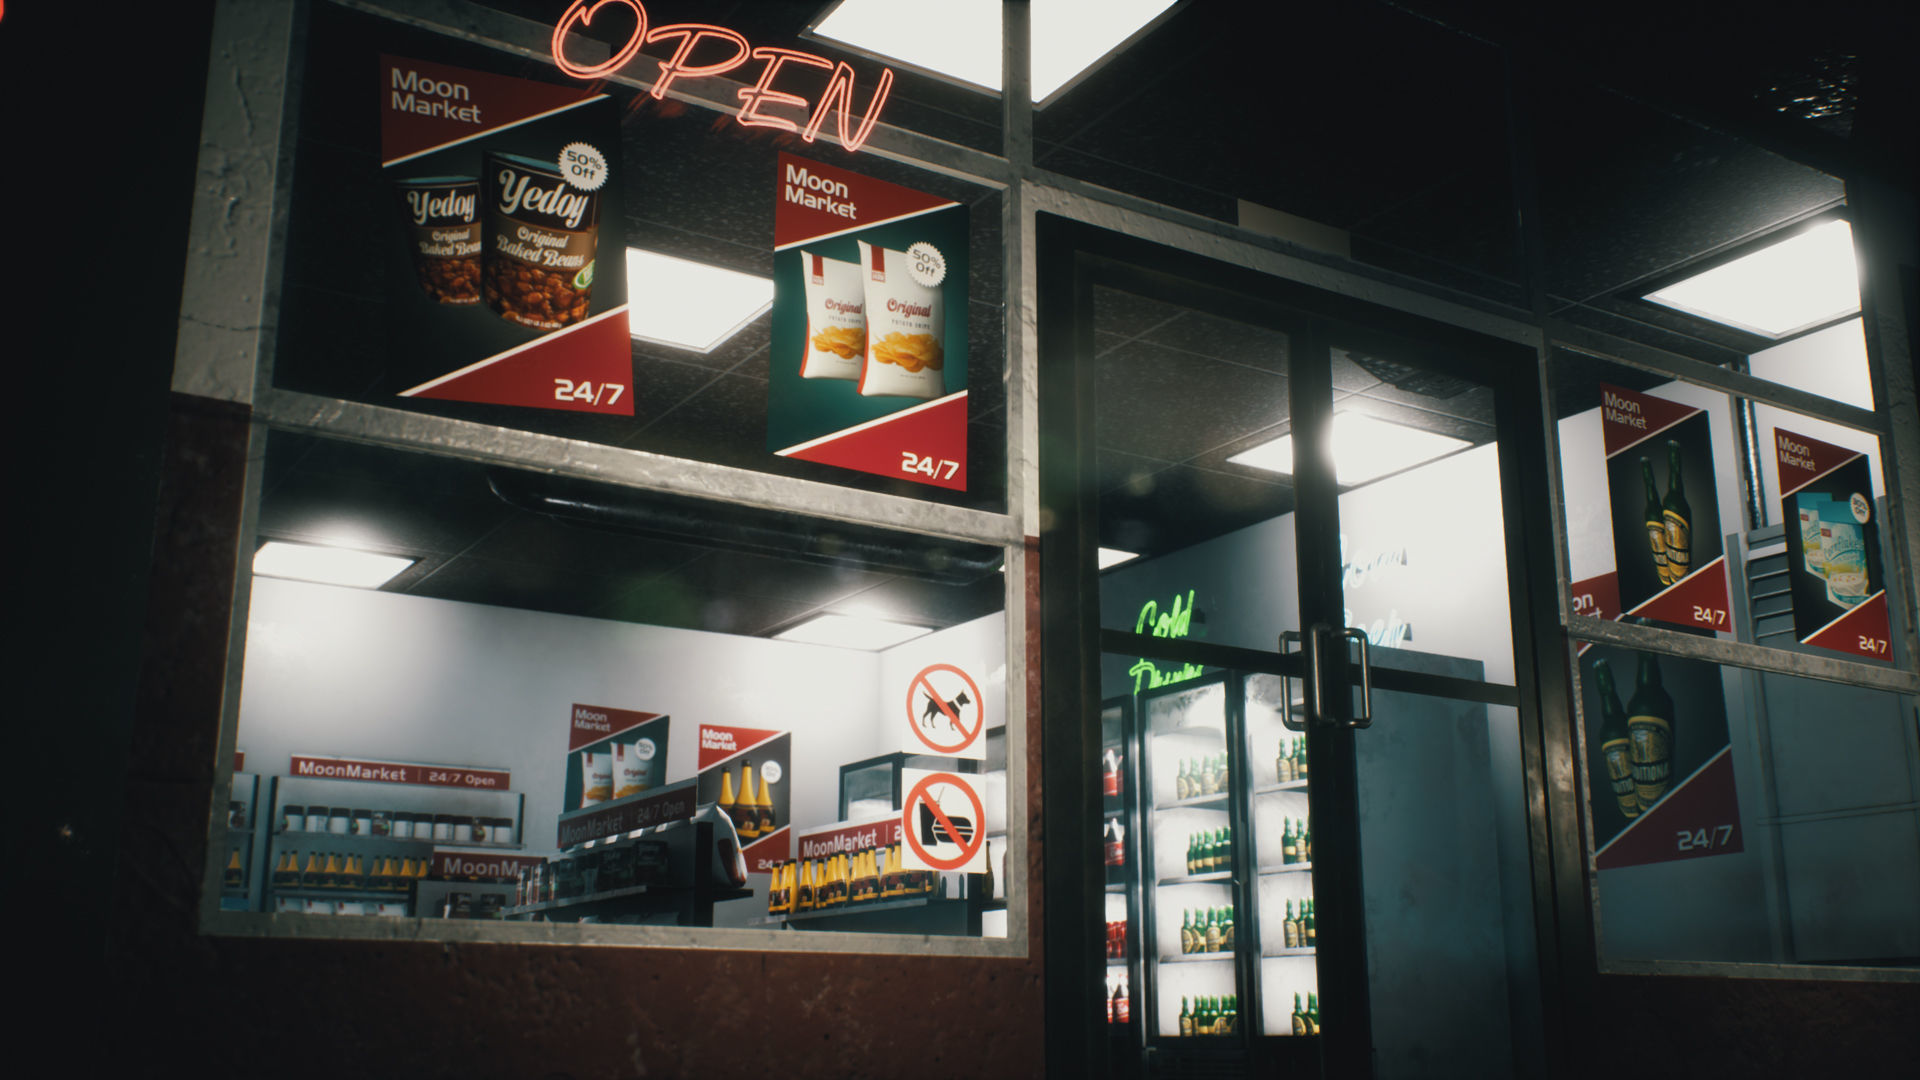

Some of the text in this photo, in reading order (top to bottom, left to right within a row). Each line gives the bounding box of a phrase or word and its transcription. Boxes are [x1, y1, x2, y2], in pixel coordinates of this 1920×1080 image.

[391, 67, 469, 101] Moon
[551, 0, 893, 151] OPEN
[391, 91, 482, 124] Market
[566, 150, 602, 171] 50%
[570, 163, 596, 181] Off
[786, 163, 848, 199] Moon
[407, 190, 476, 226] Yedoy
[498, 169, 589, 228] Yedoy
[785, 185, 857, 220] Market
[431, 228, 471, 243] Original
[517, 226, 569, 250] Original
[455, 242, 482, 256] Bean
[496, 234, 585, 268] Baked Beans
[912, 249, 942, 270] 50%
[915, 262, 936, 278] Off
[824, 298, 863, 315] Original
[887, 298, 932, 318] Original
[554, 378, 625, 406] 24/7
[1604, 391, 1641, 414] Moon
[1605, 408, 1648, 430] Market
[1778, 435, 1810, 456] Moon
[901, 451, 960, 480] 24/7
[1780, 450, 1817, 472] Market
[1693, 605, 1727, 627] 24/7
[1858, 635, 1887, 654] 24/7
[574, 708, 608, 722] Moon
[574, 719, 611, 733] Market
[702, 728, 734, 742] Moon
[702, 739, 737, 751] Market
[299, 760, 496, 787] MoonMarket 24/7 Open
[561, 814, 624, 845] MoonMarket
[1676, 824, 1734, 851] 24/7
[803, 828, 877, 857] MoonMarket
